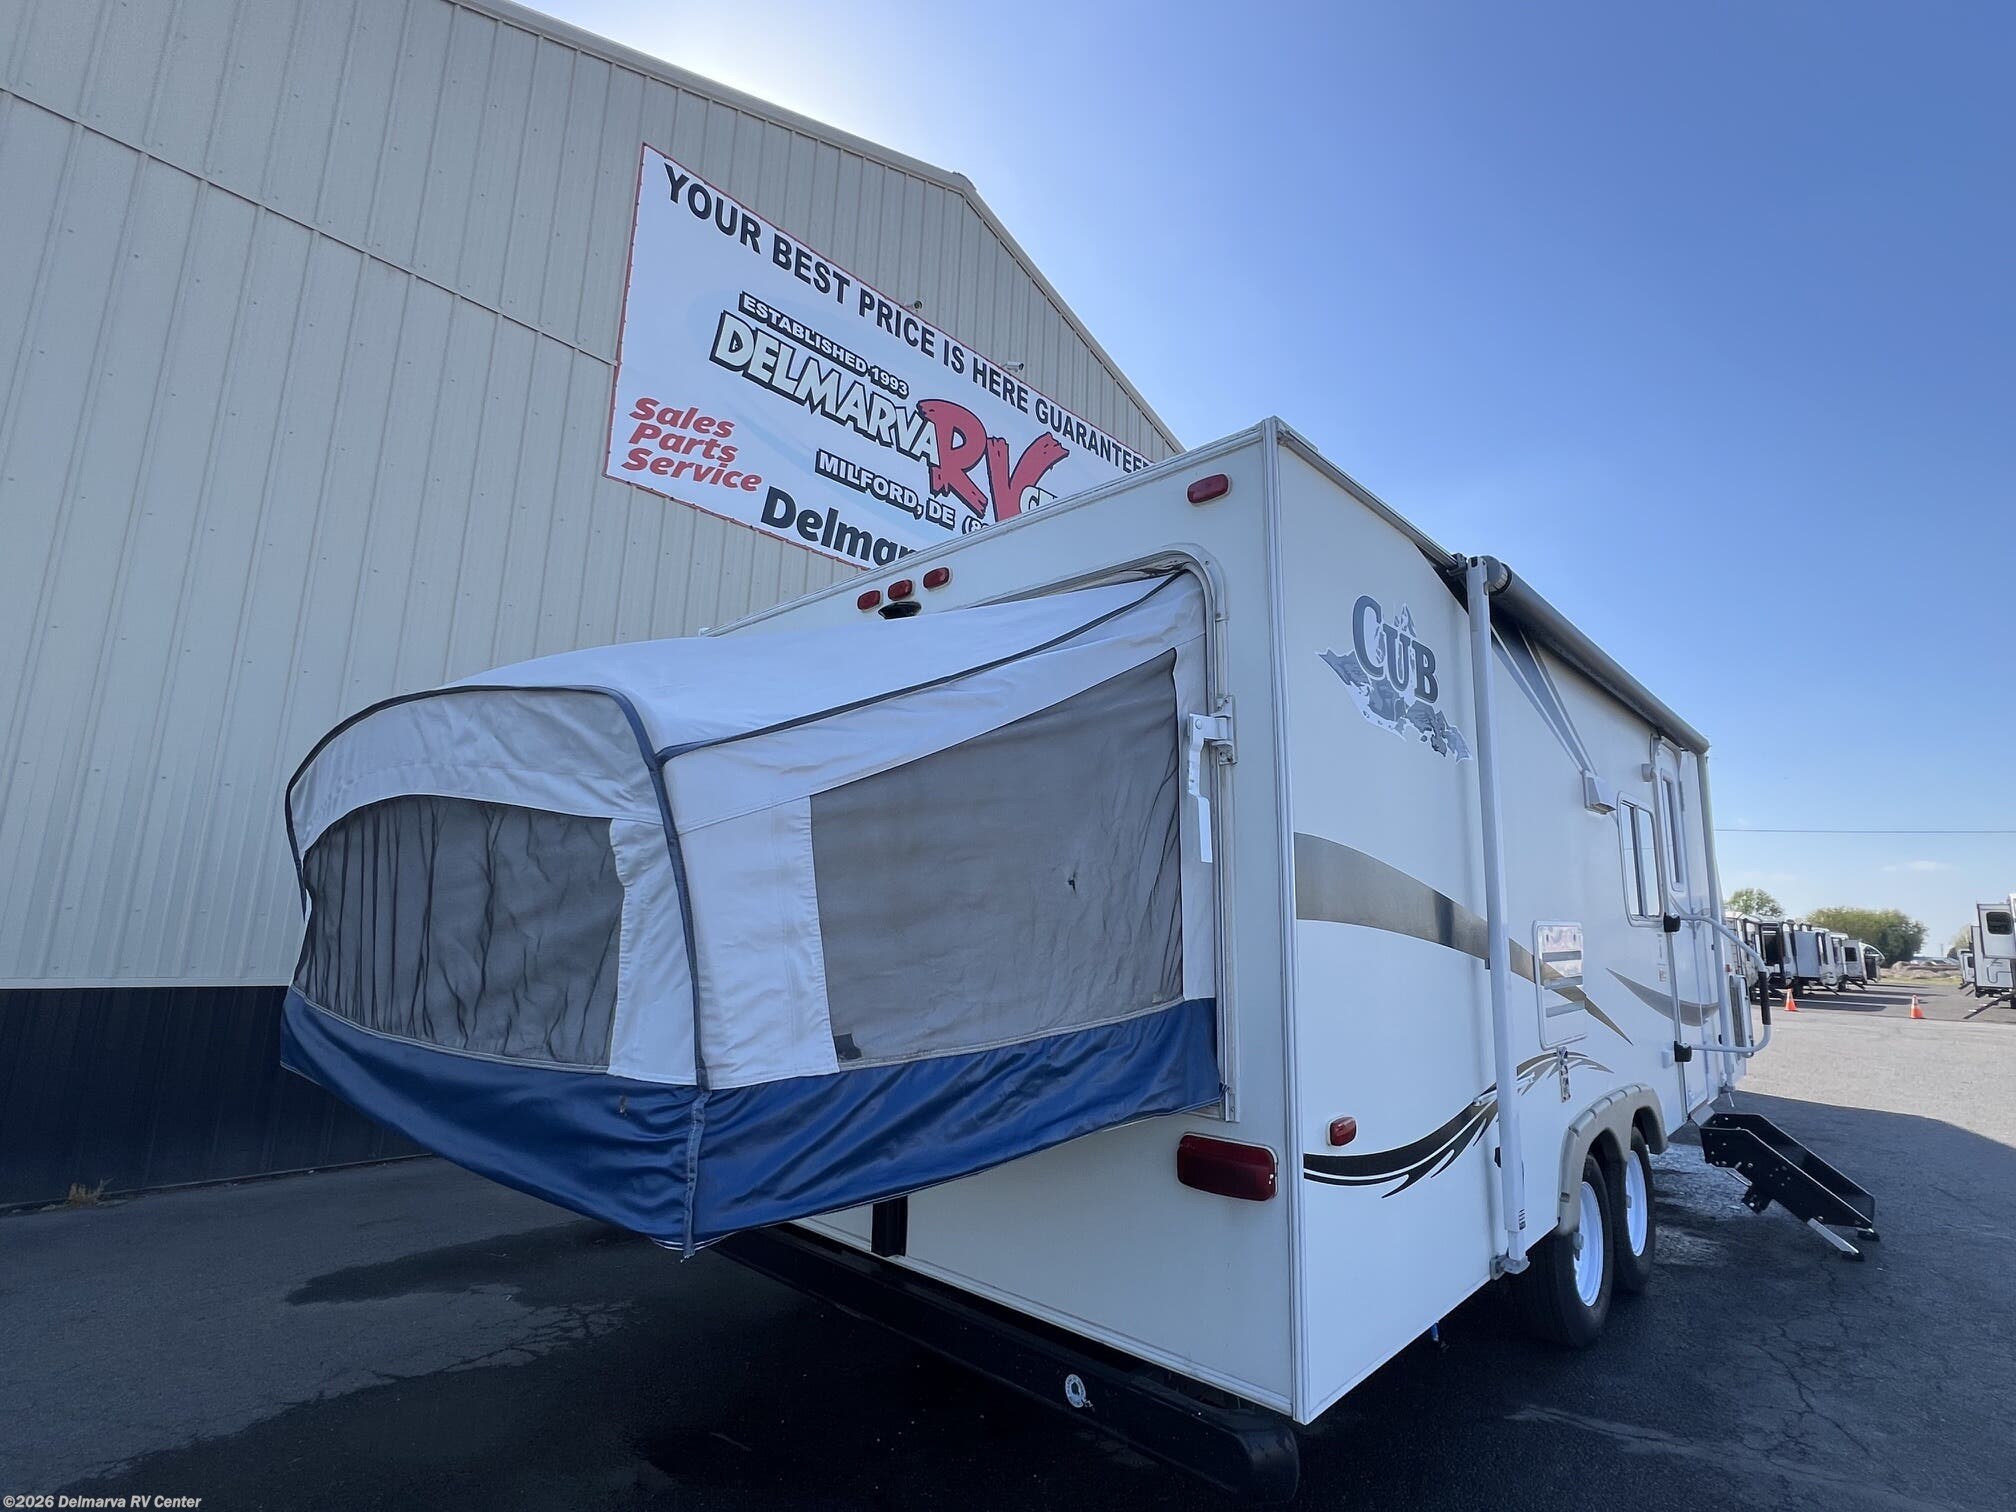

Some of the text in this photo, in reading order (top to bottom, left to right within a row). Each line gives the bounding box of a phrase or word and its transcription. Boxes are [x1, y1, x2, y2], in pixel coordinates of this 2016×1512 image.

[664, 162, 762, 255] YOUR
[772, 232, 851, 304] BEST
[858, 287, 935, 359] PRICE
[943, 339, 965, 374] IS
[973, 356, 1029, 414] HERE
[738, 291, 910, 400] ESTABLISHED 1993
[628, 397, 735, 438] Sales
[628, 422, 738, 463] Parts
[709, 310, 941, 467] DELMARVA
[916, 398, 1070, 522] RV
[621, 447, 762, 492] Service
[815, 448, 924, 520] MILFORD,
[925, 497, 956, 531] DE
[1352, 595, 1439, 704] CUB
